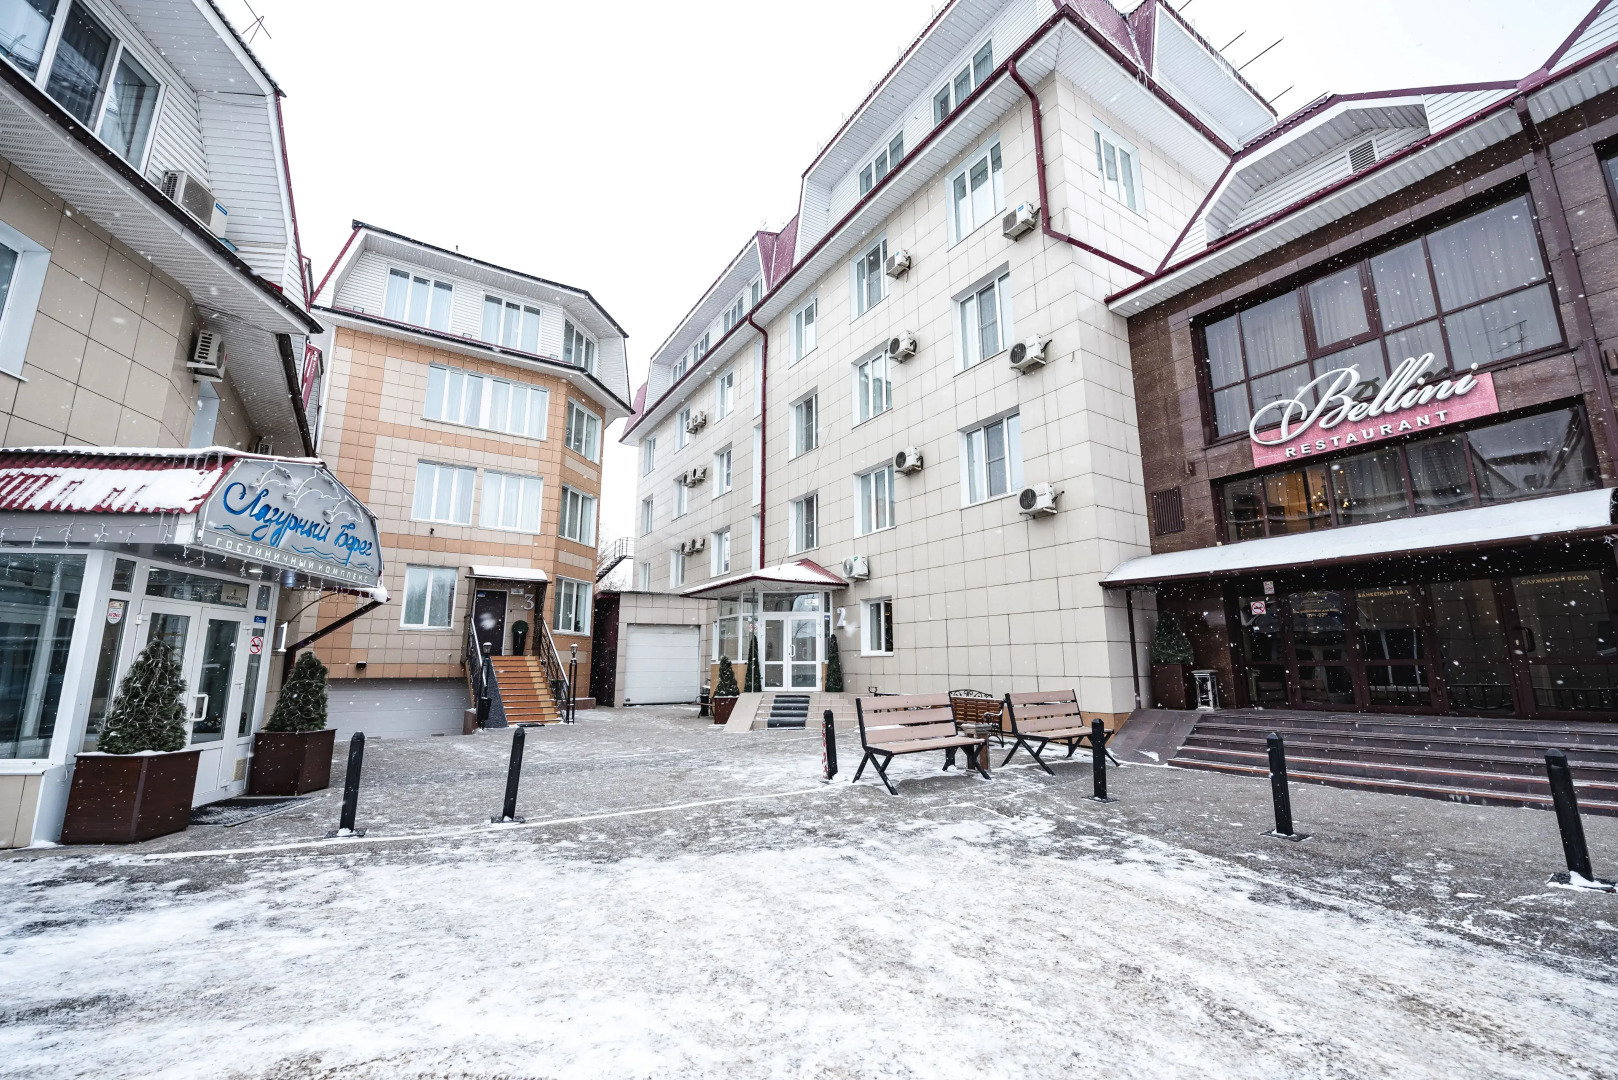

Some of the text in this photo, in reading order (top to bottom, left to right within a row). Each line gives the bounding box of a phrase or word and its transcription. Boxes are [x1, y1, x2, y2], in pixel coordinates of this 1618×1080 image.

[1249, 352, 1479, 446] Bellini
[1284, 409, 1449, 458] RESTAURANT
[223, 481, 373, 567] Лазурный Берег
[215, 537, 369, 584] ГОСТИНИЧНЫЙ КОМПЛЕКС
[524, 593, 535, 610] 3
[277, 621, 289, 652] 1
